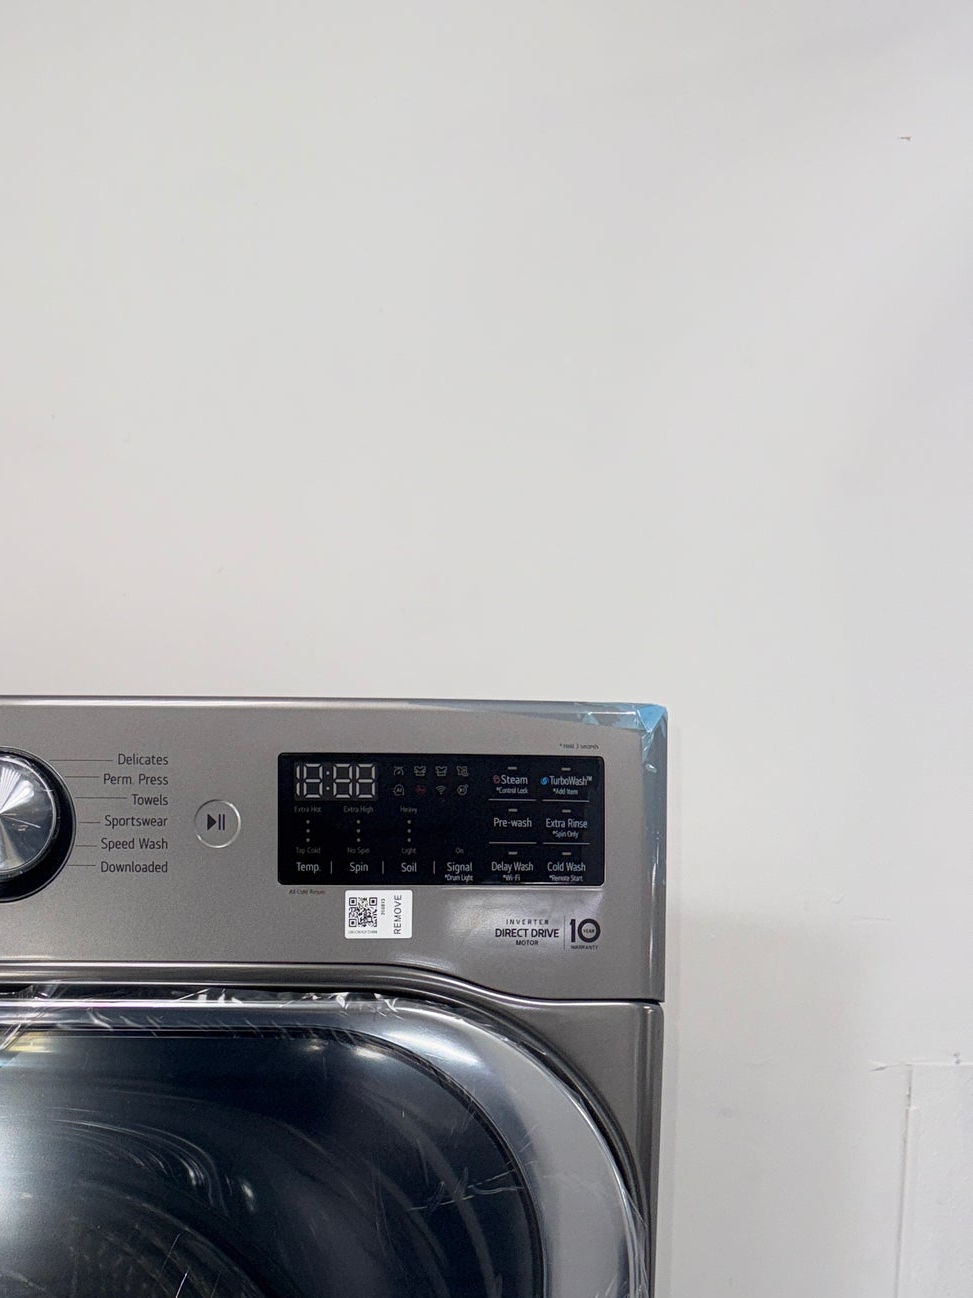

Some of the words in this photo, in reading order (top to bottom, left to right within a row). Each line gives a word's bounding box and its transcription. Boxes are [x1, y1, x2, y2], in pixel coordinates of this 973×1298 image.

[117, 753, 169, 766] Delicates
[138, 773, 169, 786] Press
[501, 774, 529, 785] Steam
[517, 786, 529, 795] Lock
[131, 793, 169, 806] Towels
[343, 805, 359, 813] Extra
[360, 805, 374, 815] High
[104, 814, 168, 829] Sportswear
[493, 817, 533, 828] Pre-wash
[545, 818, 566, 829] Extra
[567, 818, 588, 829] Rinse
[567, 830, 580, 839] Only
[100, 837, 135, 852] Speed
[138, 837, 169, 850] Wash
[347, 846, 356, 854] No
[357, 846, 371, 855] Spin
[455, 847, 464, 855] On
[100, 861, 168, 873] Downloaded
[296, 861, 322, 875] Temp.
[349, 861, 369, 875] Spin
[400, 861, 418, 873] Soil
[446, 861, 473, 875] Signal
[491, 862, 513, 874] Delay
[513, 862, 534, 872] Wash
[547, 862, 564, 872] Cold
[565, 862, 586, 872] Wash
[460, 874, 473, 884] Light
[570, 874, 583, 882] Start
[393, 894, 403, 935] REMOVE
[495, 928, 529, 938] DIRECT
[531, 928, 559, 938] DRIVE
[569, 918, 601, 943] 10
